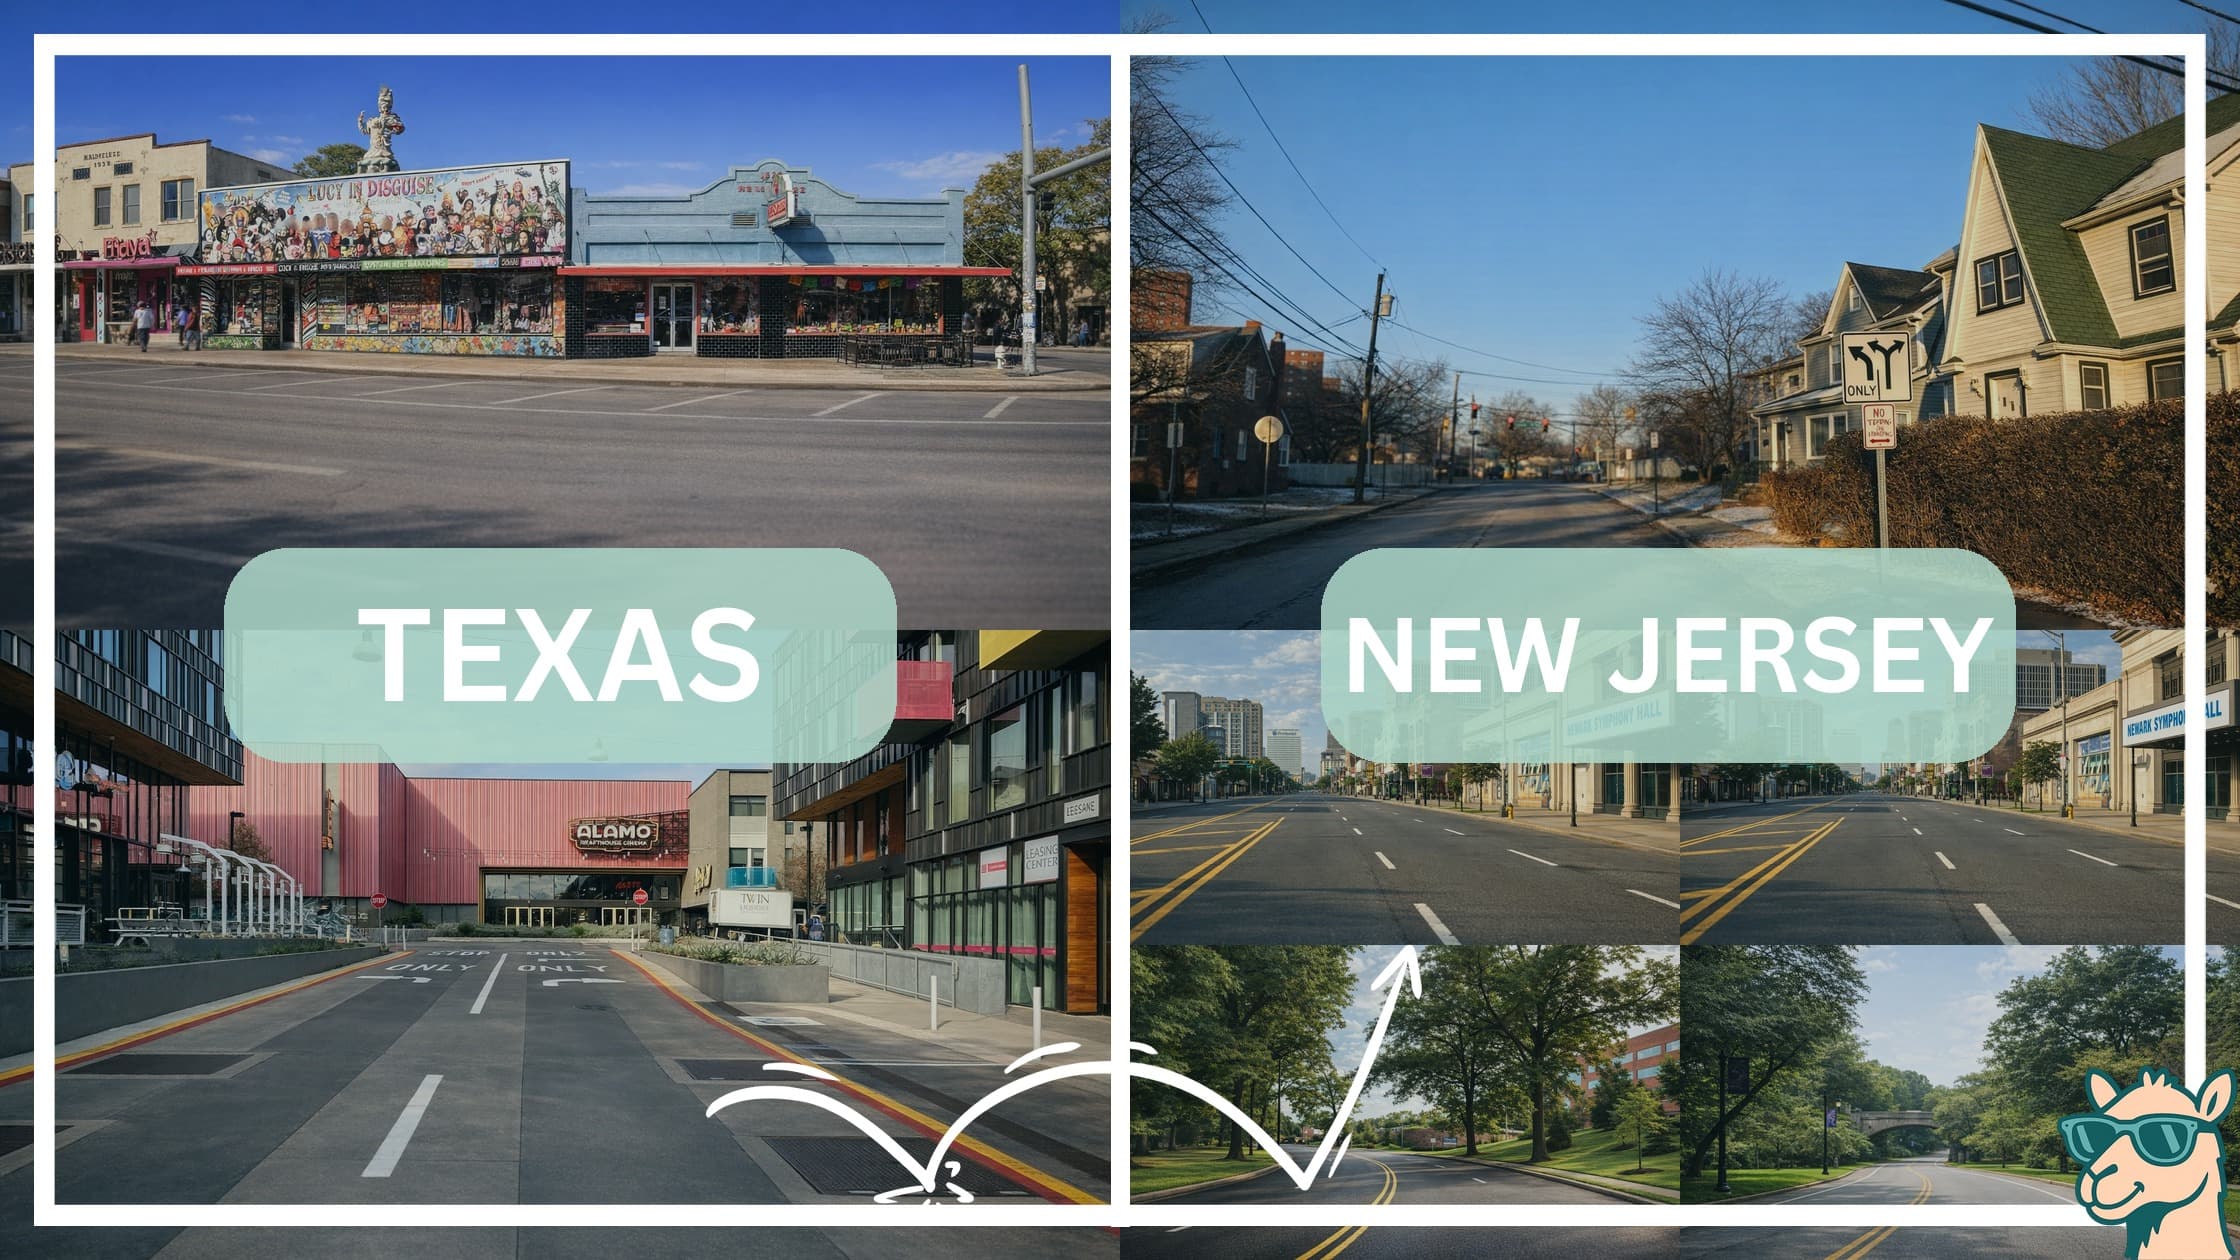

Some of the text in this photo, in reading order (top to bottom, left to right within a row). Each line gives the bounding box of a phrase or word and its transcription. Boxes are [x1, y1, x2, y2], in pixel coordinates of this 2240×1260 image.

[307, 176, 434, 201] LUCY IN DISGUISE
[1847, 385, 1877, 396] ONLY
[1873, 408, 1885, 418] NO
[1636, 701, 1662, 720] HALL
[2127, 699, 2222, 737] NEWARK SYMPHO ALL
[576, 824, 651, 839] ALAMO
[1026, 843, 1058, 860] LEASING
[1026, 857, 1058, 870] CENTER
[385, 964, 479, 972] ONLY
[516, 964, 609, 973] ONLY
